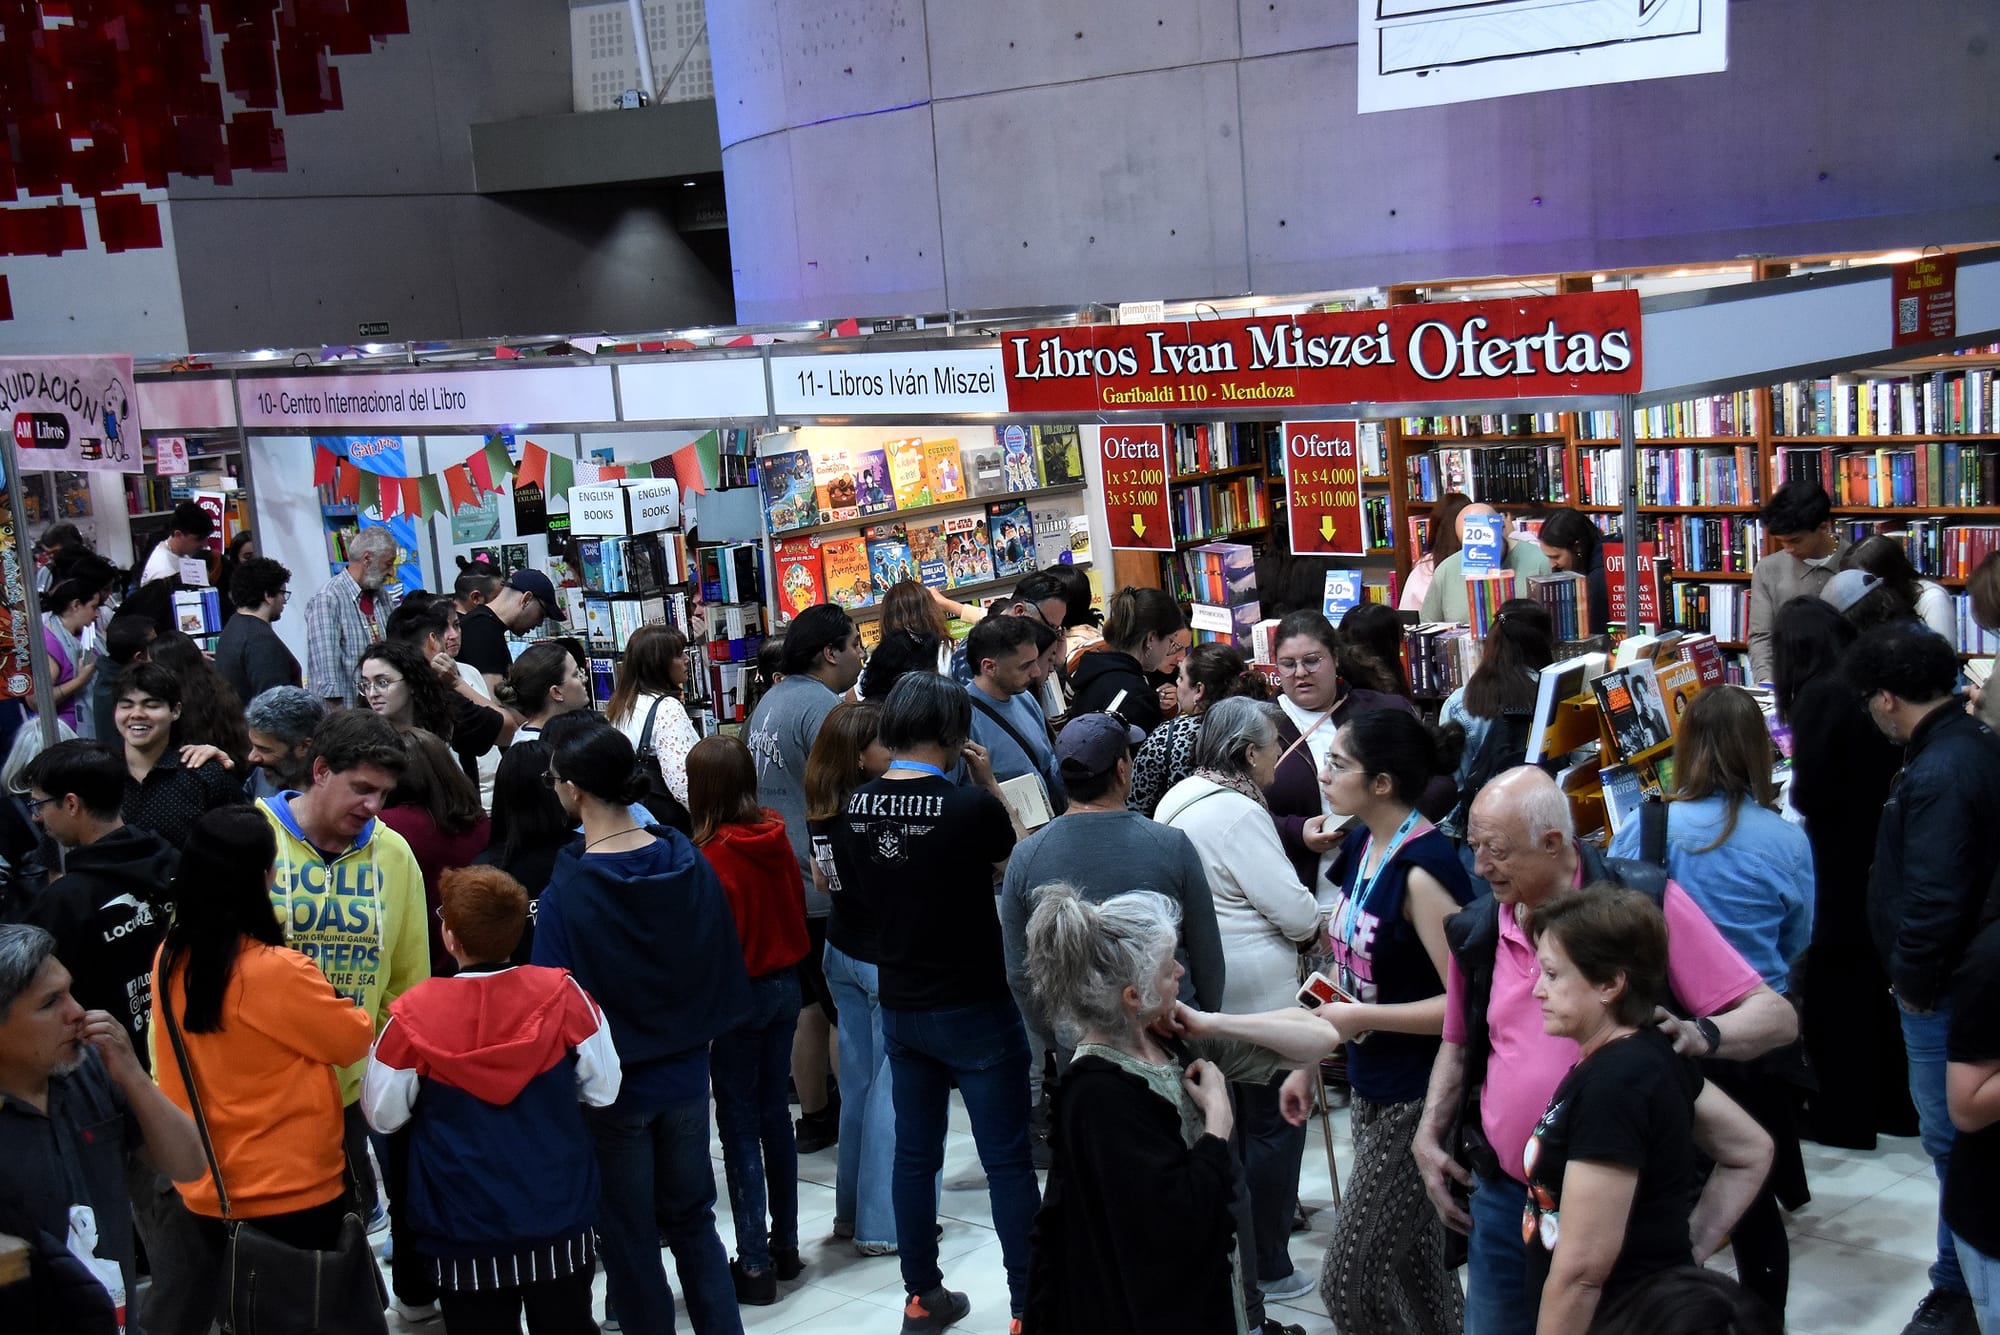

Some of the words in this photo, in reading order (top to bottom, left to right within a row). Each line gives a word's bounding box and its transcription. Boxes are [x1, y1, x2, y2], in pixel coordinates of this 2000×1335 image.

[1009, 335, 1139, 381] Libros
[1145, 330, 1239, 374] Ivan
[1246, 322, 1396, 371] Miszei
[1407, 316, 1633, 381] Ofertas
[797, 369, 823, 396] 11-
[828, 368, 884, 396] Libros
[889, 367, 929, 395] Iván
[934, 365, 996, 395] Miszei
[258, 392, 277, 414] 10-
[281, 391, 321, 414] Centro
[324, 388, 405, 414] Internacional
[409, 387, 429, 411] del
[432, 386, 466, 411] Libro
[1102, 383, 1175, 405] Garibaldi
[1178, 383, 1208, 403] 110
[1221, 381, 1296, 401] Mendoza
[16, 421, 32, 438] AM
[36, 421, 65, 439] Libros
[1104, 437, 1160, 460] Oferta
[1291, 434, 1353, 459] Oferta
[1106, 469, 1120, 485] 1x
[1293, 469, 1309, 485] 1x
[578, 491, 614, 502] ENGLISH
[638, 486, 671, 501] ENGLISH
[1107, 490, 1120, 506] 3x
[1294, 491, 1308, 507] 3x
[584, 509, 614, 520] BOOKS
[642, 504, 670, 519] BOOKS
[838, 541, 855, 555] 365
[1468, 547, 1477, 560] 6
[829, 563, 869, 579] Aventuras
[1606, 555, 1651, 573] OFTA
[1613, 594, 1623, 602] DE
[1329, 601, 1338, 613] 6
[1612, 602, 1653, 611] COMTAS
[1665, 666, 1697, 691] mafalda
[271, 858, 384, 897] GOLD
[271, 896, 386, 936] COAST
[311, 933, 345, 942] GENUINE
[290, 942, 380, 973] RFERS
[331, 972, 353, 985] THE
[358, 973, 376, 986] SEA
